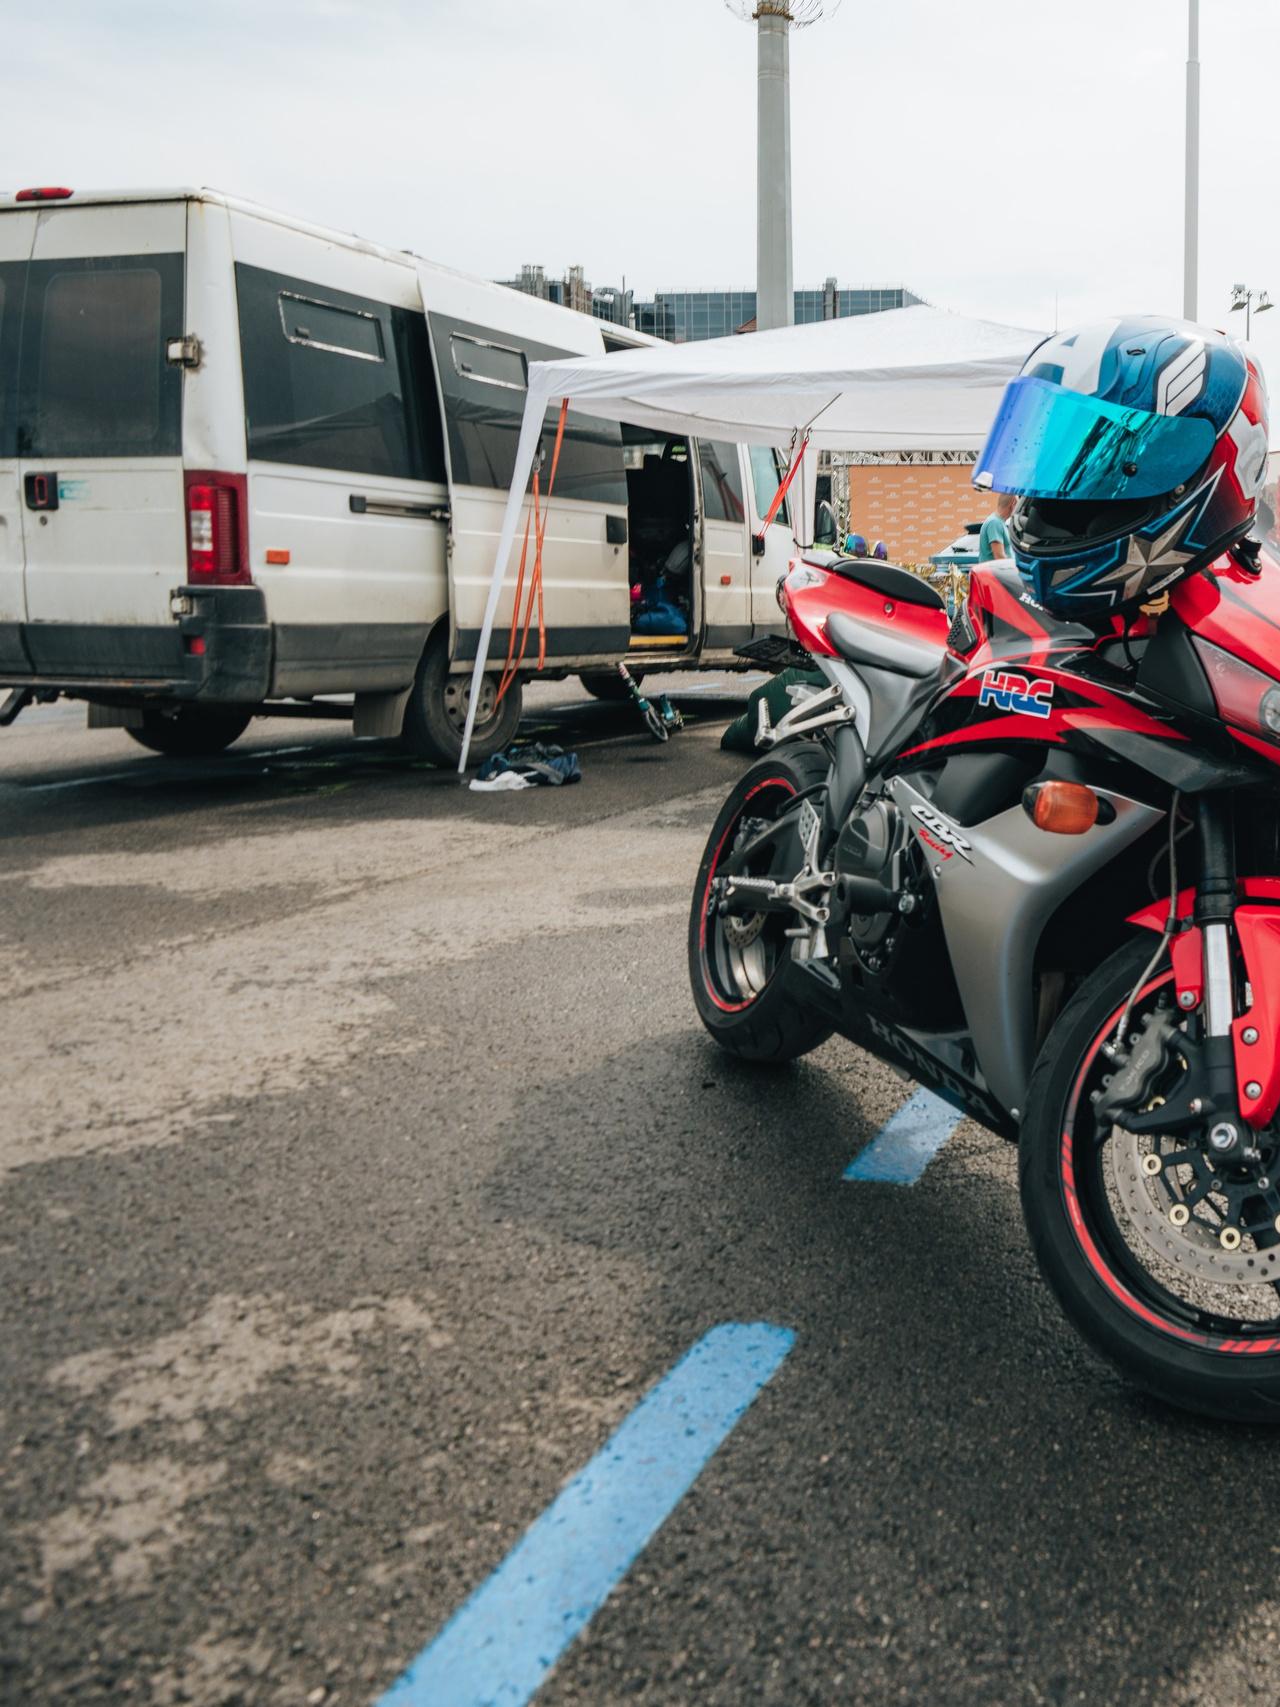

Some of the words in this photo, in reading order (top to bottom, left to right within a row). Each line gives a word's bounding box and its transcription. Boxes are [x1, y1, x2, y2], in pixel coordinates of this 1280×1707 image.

[979, 669, 1054, 719] HRC
[910, 804, 976, 868] CBR
[918, 828, 954, 861] Racing
[866, 1012, 1000, 1124] HONDA
